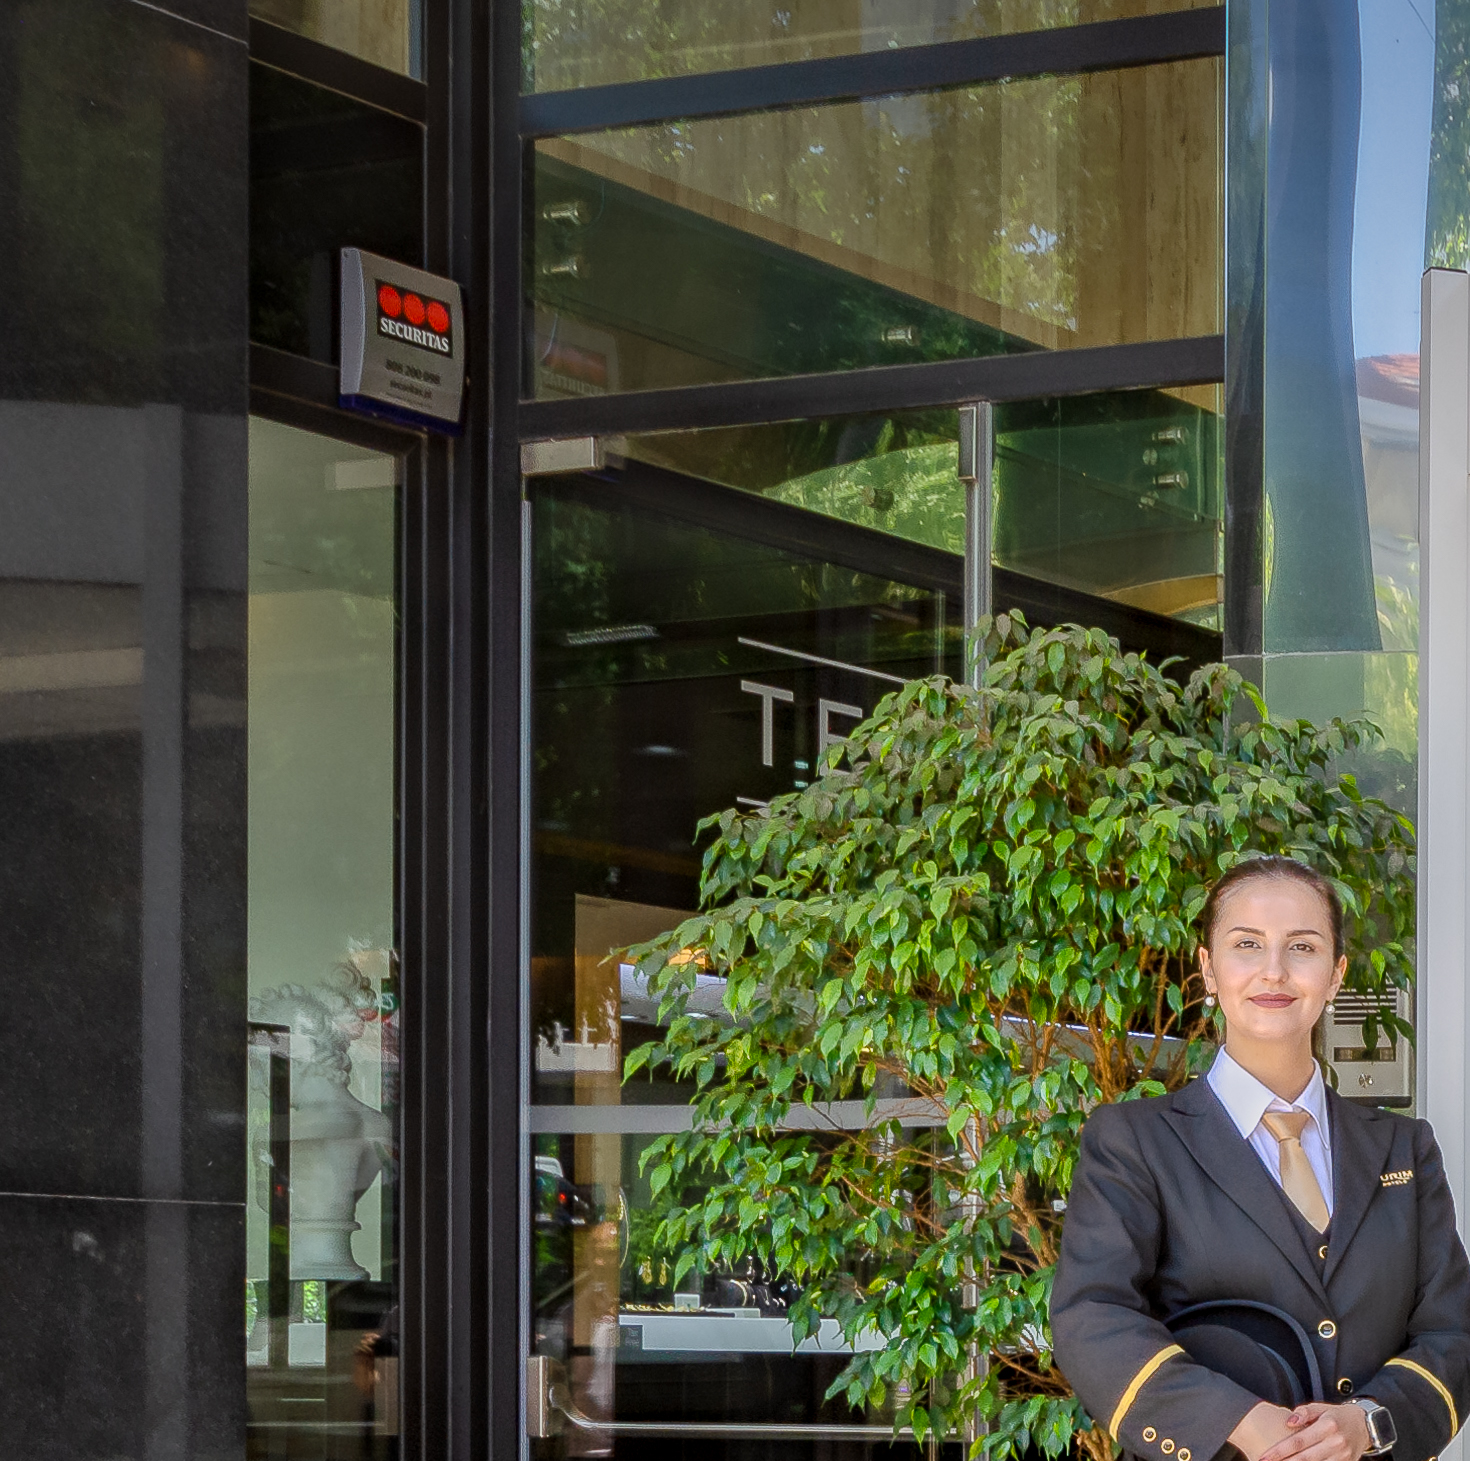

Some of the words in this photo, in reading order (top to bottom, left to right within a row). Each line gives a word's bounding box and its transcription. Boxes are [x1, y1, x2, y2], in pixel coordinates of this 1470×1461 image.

[380, 317, 449, 352] SECURITAS
[740, 679, 864, 787] TE
[1380, 1169, 1414, 1181] URIM
